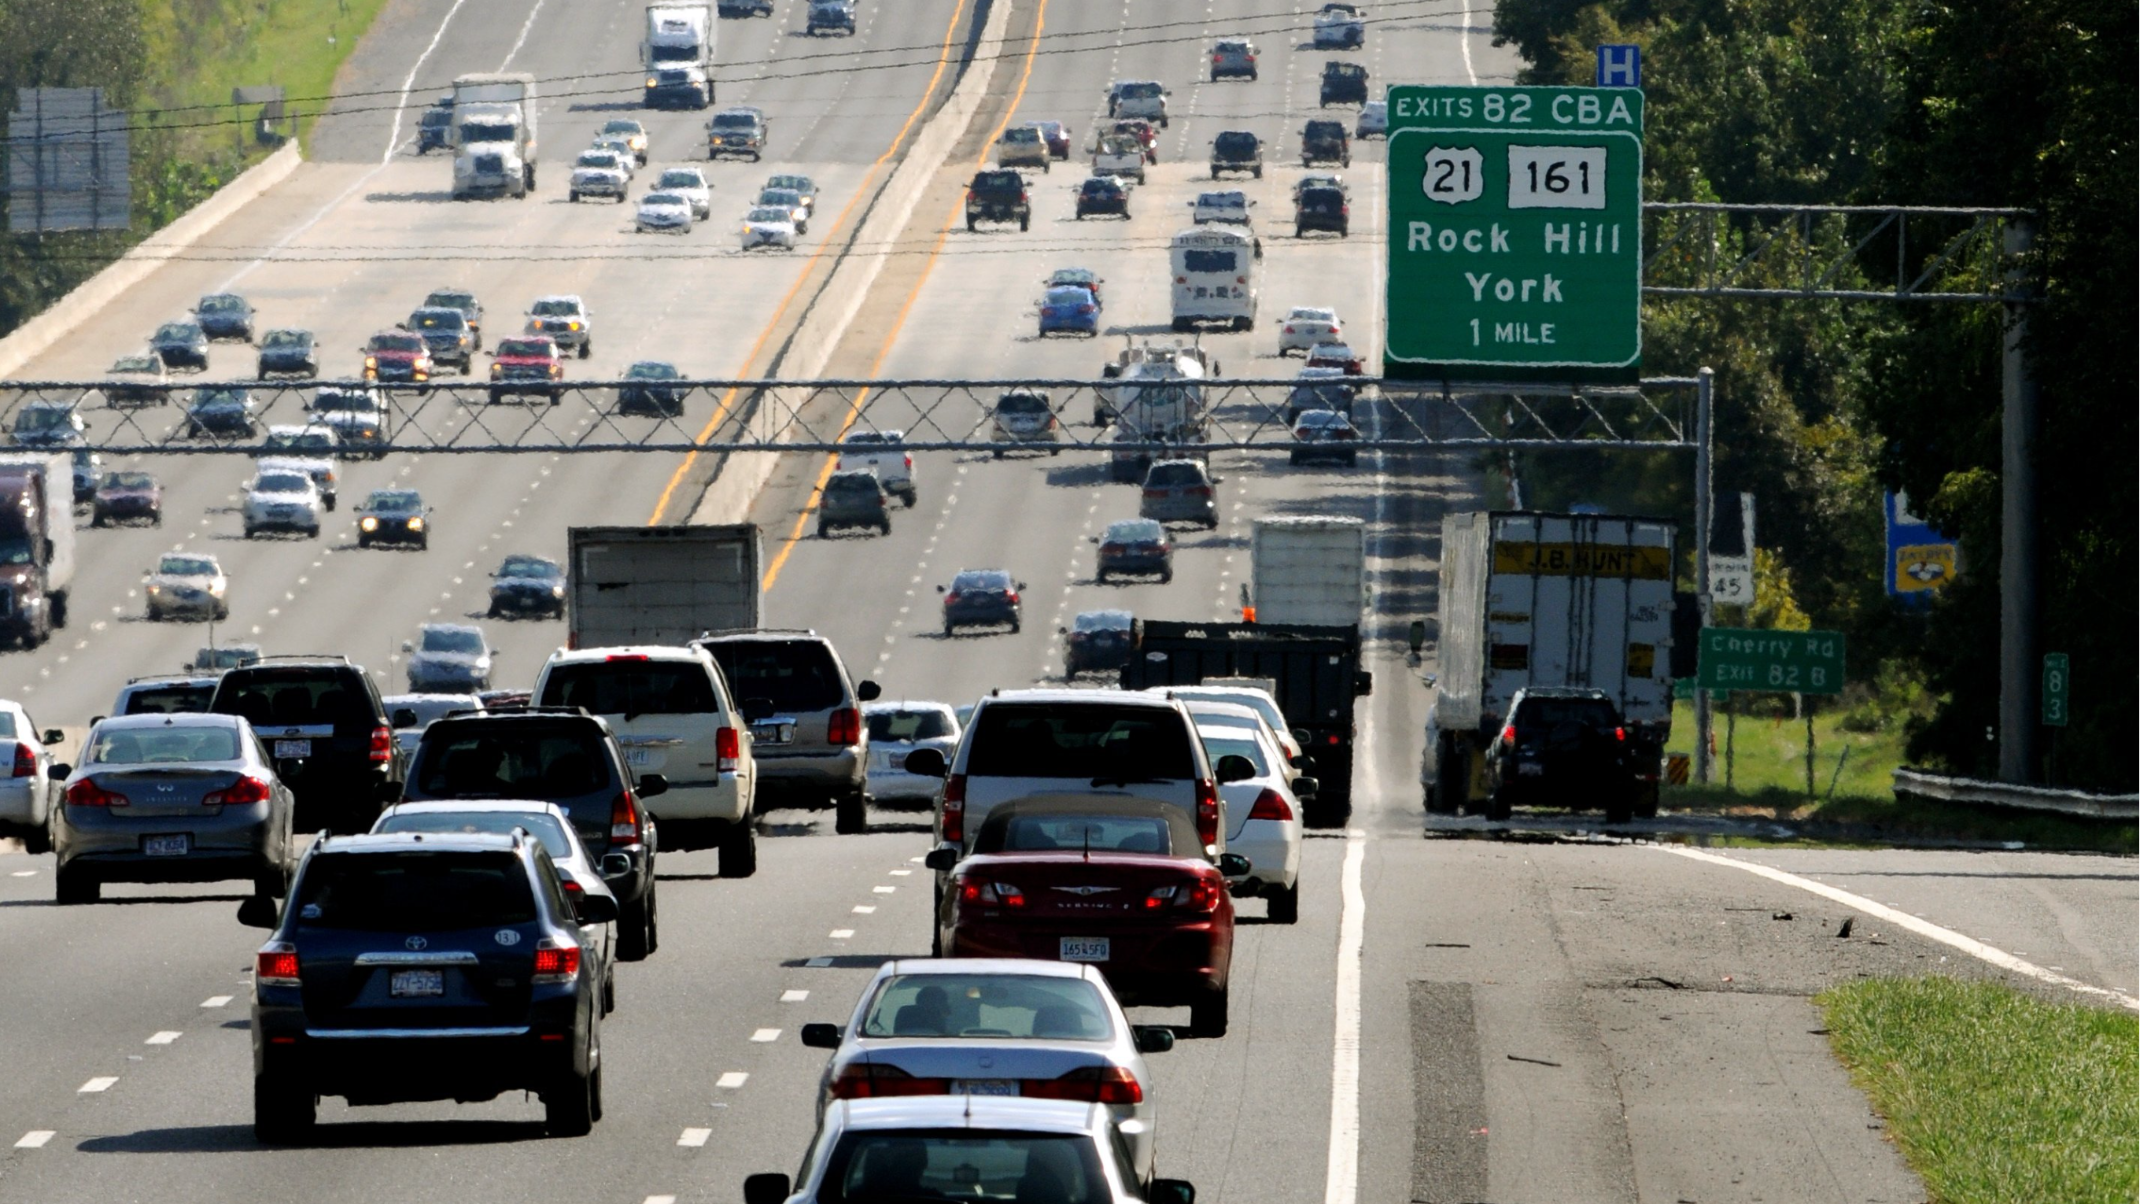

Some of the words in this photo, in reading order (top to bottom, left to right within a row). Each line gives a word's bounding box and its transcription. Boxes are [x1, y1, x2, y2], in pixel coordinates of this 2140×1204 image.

[1604, 48, 1634, 84] H
[1396, 97, 1473, 117] EXITS
[1483, 94, 1532, 123] 82
[1551, 94, 1633, 124] CBA
[1433, 159, 1470, 193] 21
[1527, 161, 1589, 194] 161
[1408, 221, 1510, 252] Rock
[1544, 221, 1620, 254] Hill
[1465, 272, 1563, 303] York
[1470, 318, 1480, 346] 1
[1495, 322, 1556, 344] MILE
[1528, 549, 1570, 570] J.B.
[1575, 549, 1635, 571] HUNT
[1714, 576, 1742, 597] 45
[1711, 635, 1793, 659] Cherry
[1806, 637, 1834, 658] Rd
[1768, 663, 1800, 686] 82
[498, 932, 517, 943] 13.1
[1064, 944, 1081, 955] 165
